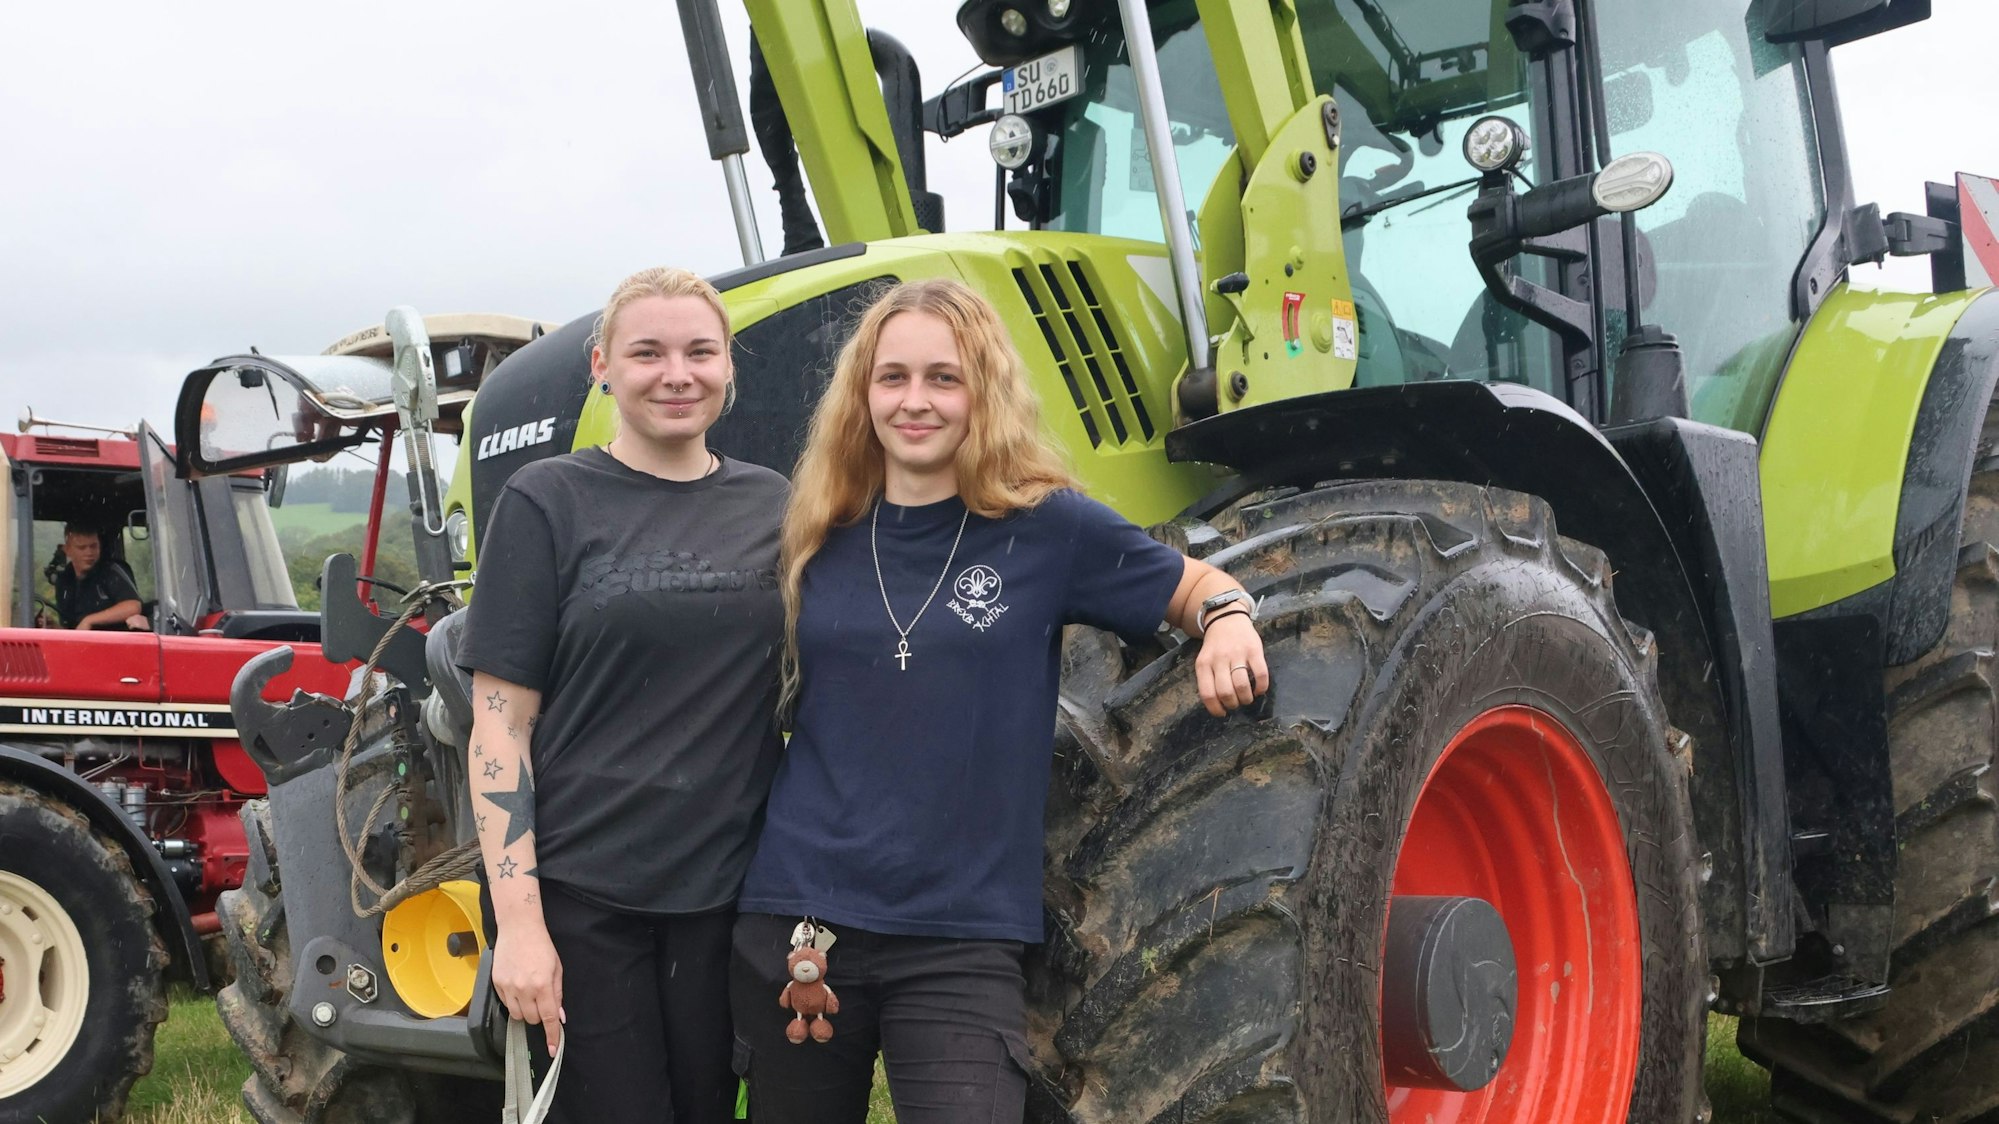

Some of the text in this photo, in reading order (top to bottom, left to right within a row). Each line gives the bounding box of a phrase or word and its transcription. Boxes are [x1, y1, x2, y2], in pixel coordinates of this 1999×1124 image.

[1017, 61, 1041, 89] SU
[477, 416, 557, 461] CLAAS
[21, 707, 210, 728] INTERNATIONAL
